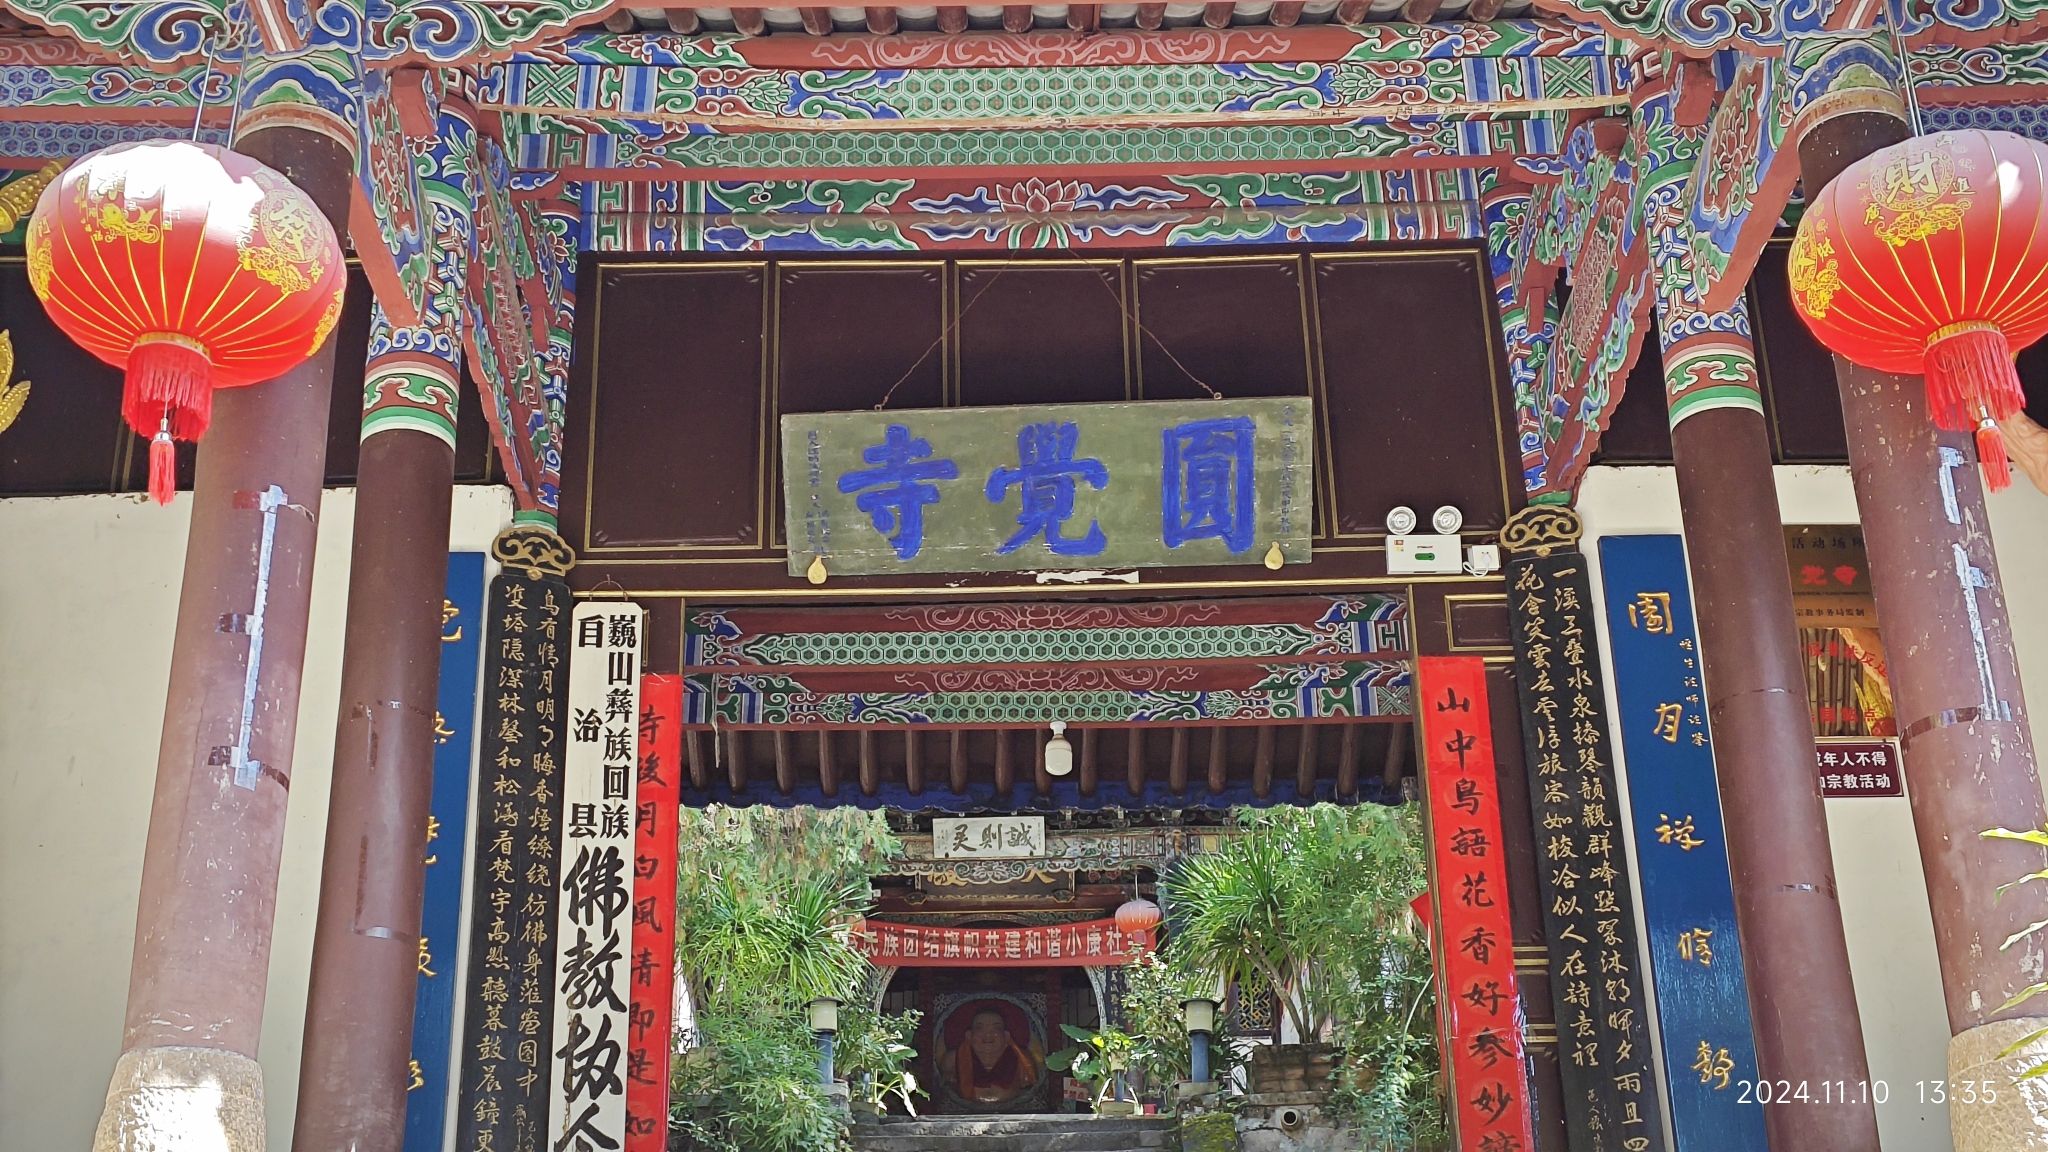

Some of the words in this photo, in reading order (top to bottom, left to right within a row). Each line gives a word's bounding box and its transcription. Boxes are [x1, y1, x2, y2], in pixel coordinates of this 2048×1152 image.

[568, 615, 606, 839] 自治县
[836, 924, 1147, 959] 民族团结旗帜共建和谐小康社
